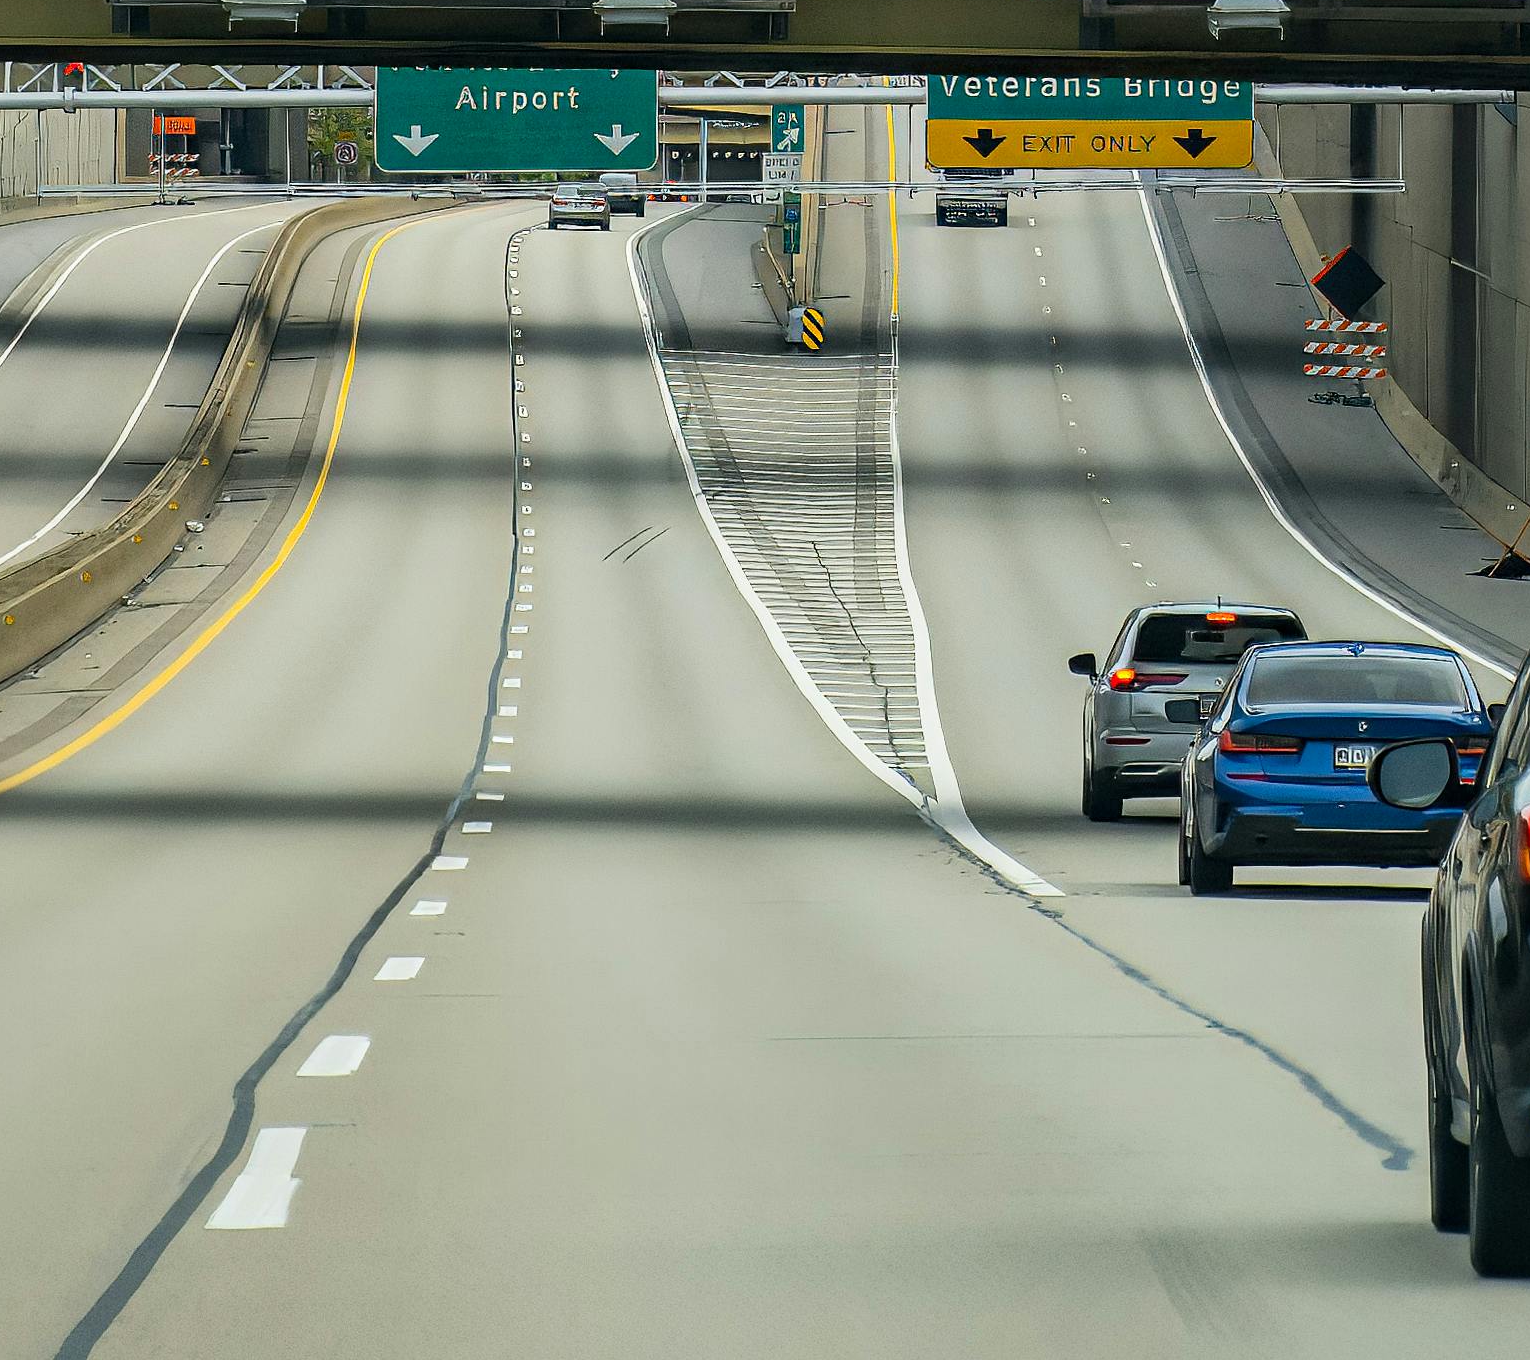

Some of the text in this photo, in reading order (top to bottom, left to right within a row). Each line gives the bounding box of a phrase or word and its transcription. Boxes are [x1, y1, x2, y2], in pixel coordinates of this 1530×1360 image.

[939, 75, 1101, 98] Veterans
[454, 86, 580, 114] Airport
[1022, 135, 1158, 153] EXIT ONLY
